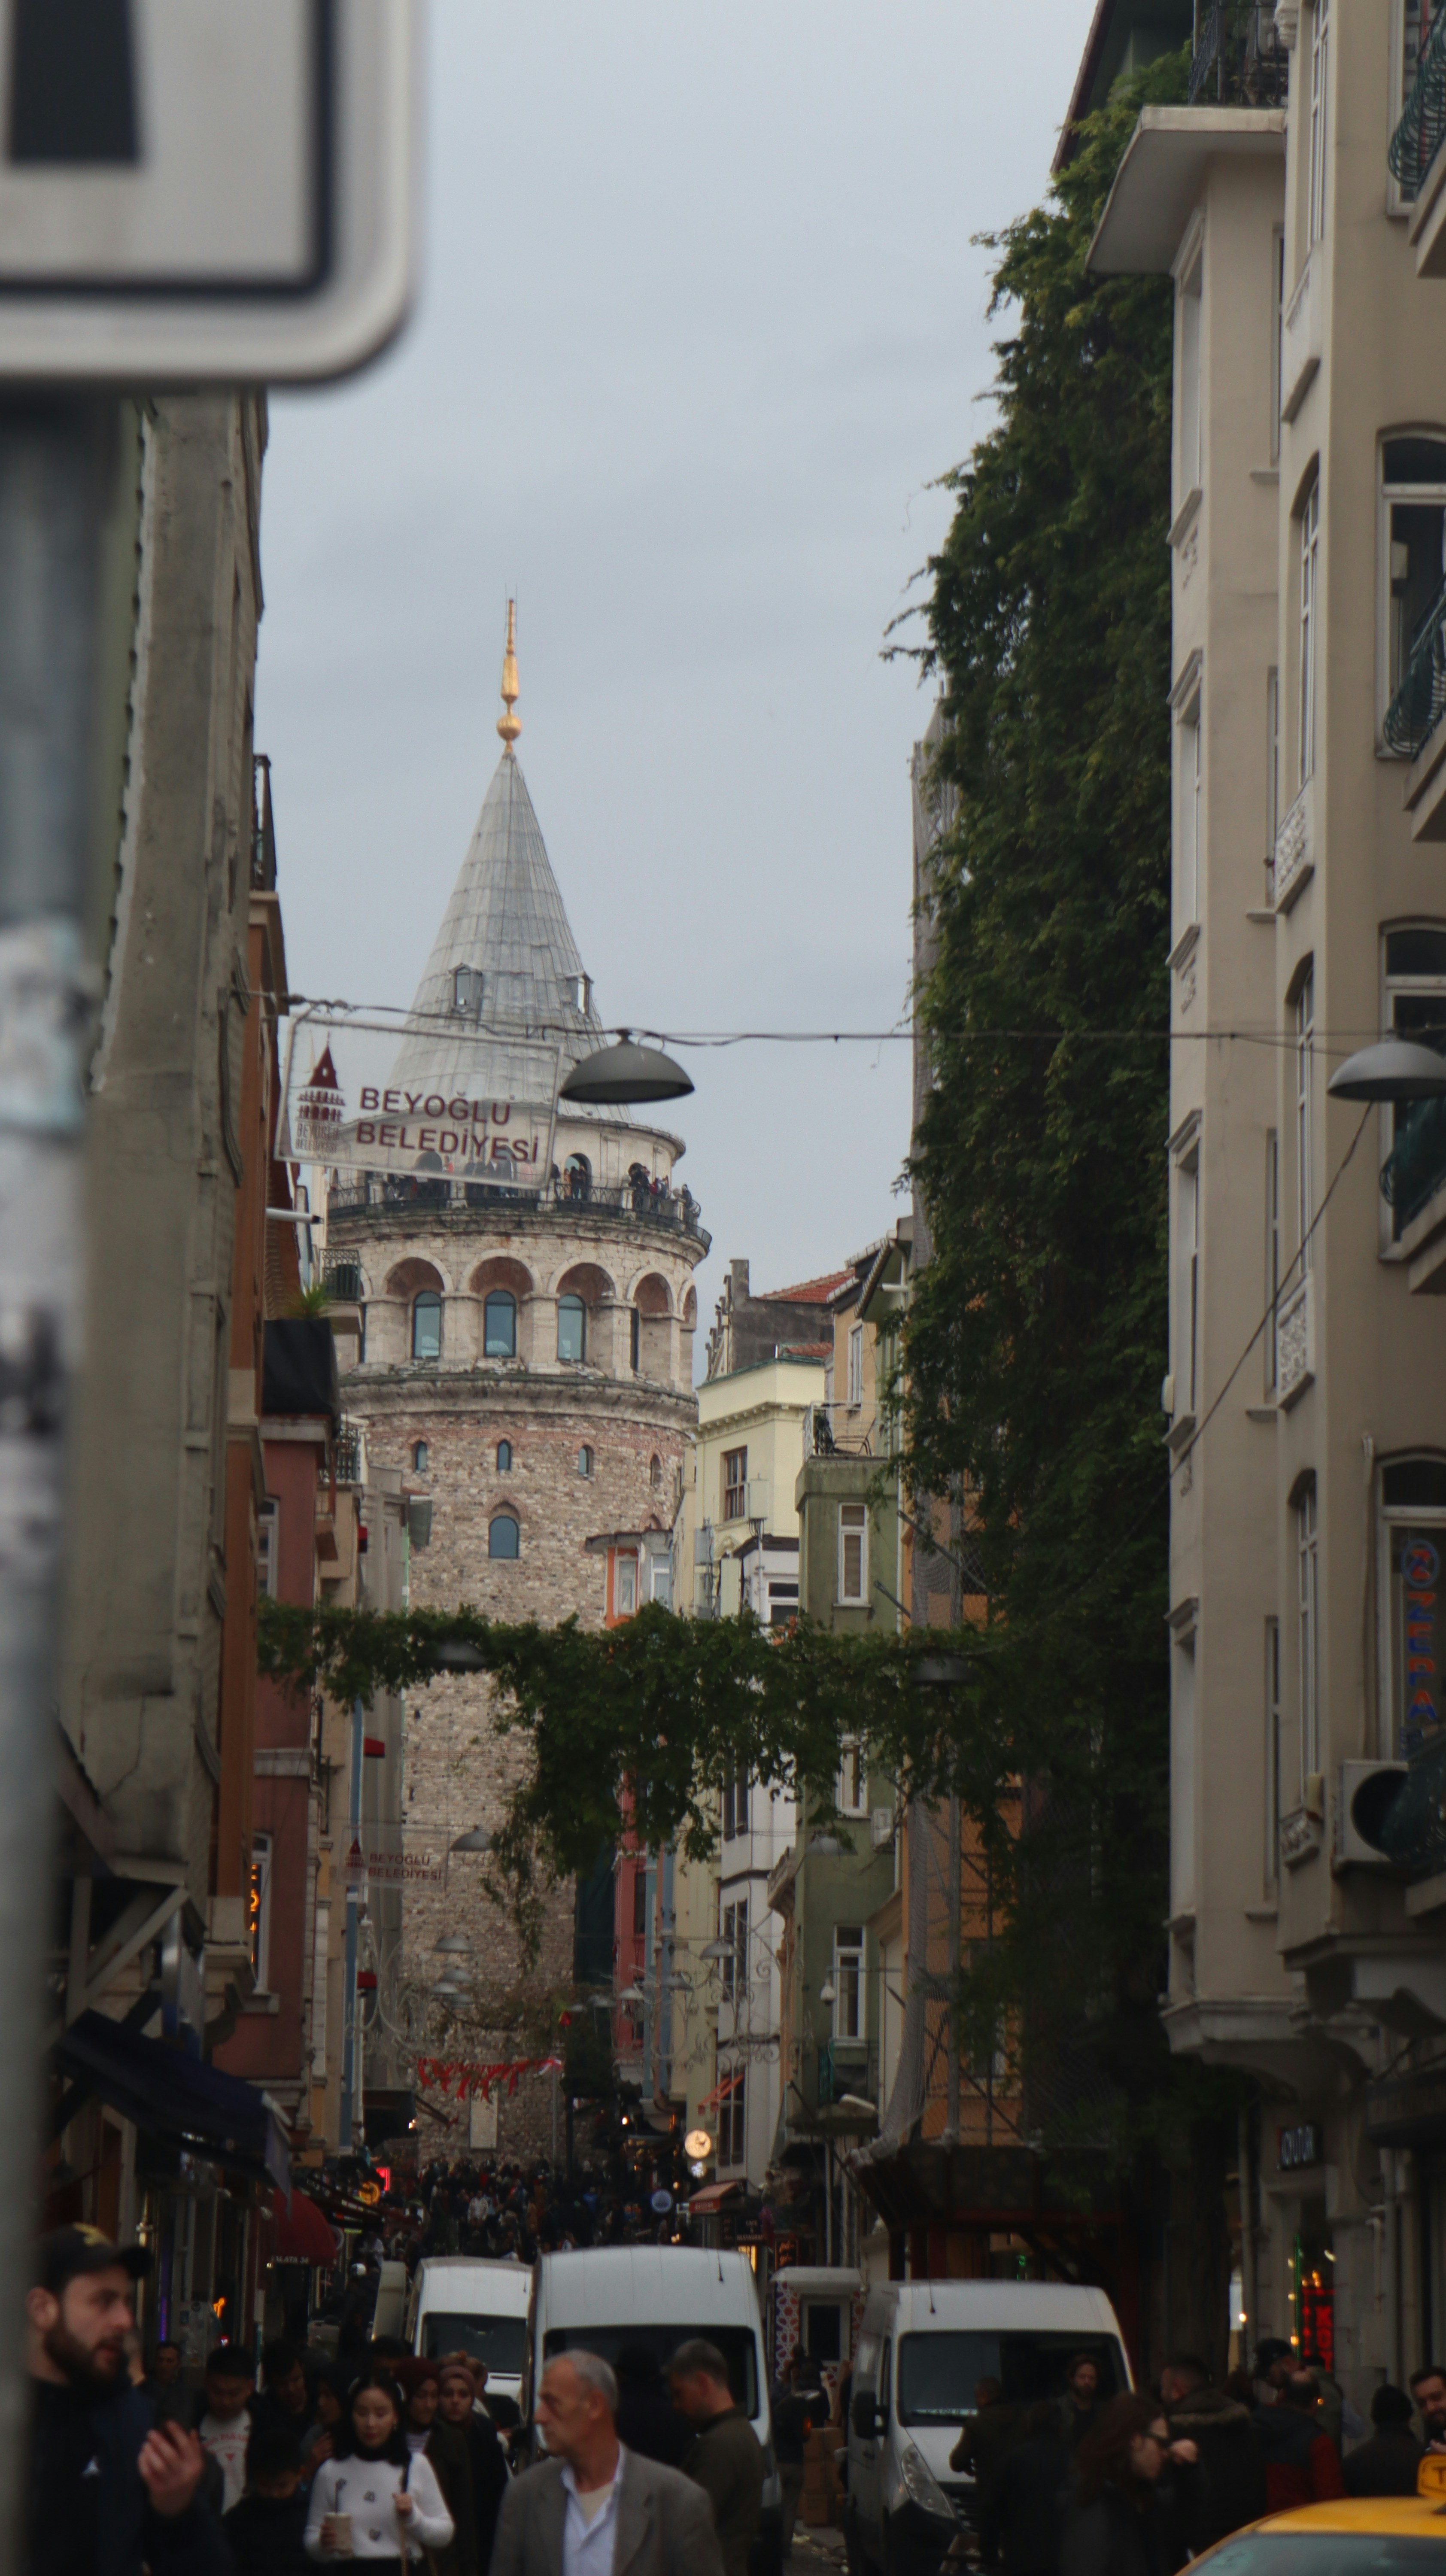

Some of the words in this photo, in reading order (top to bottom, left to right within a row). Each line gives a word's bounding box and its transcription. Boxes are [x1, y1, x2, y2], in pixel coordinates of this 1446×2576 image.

[360, 1087, 511, 1125] BEYOĞLU
[356, 1121, 539, 1163] BELEDİYESİ
[370, 1853, 430, 1865] BEYOĞLU
[368, 1867, 441, 1880] BELEDİYESİ
